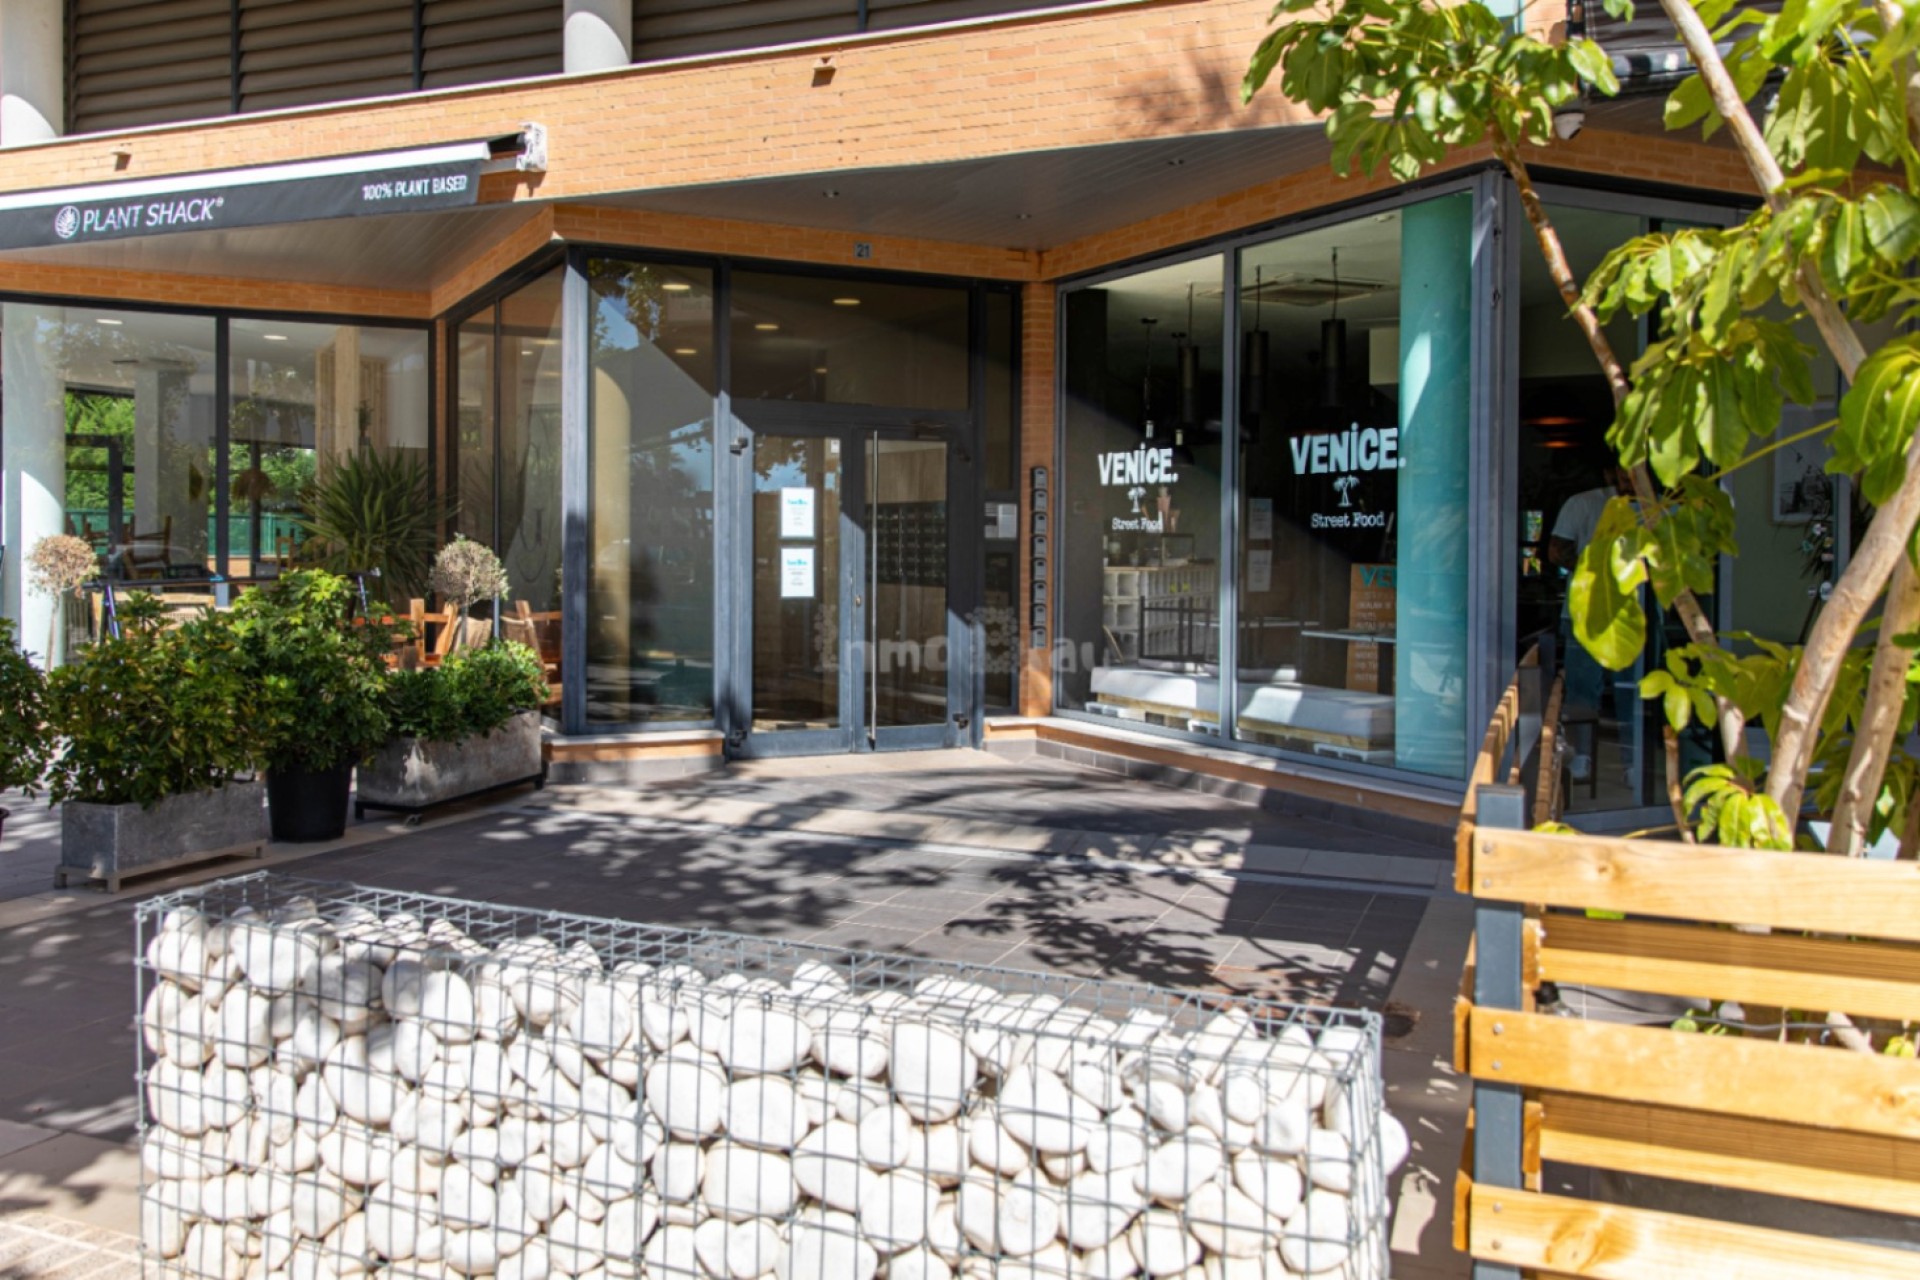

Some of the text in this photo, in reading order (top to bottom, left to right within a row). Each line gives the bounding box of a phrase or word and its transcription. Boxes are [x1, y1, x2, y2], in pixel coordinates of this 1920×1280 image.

[362, 175, 467, 200] 100% PLANT BASED
[83, 204, 144, 232] PLANT
[856, 243, 870, 258] 21
[1112, 516, 1139, 530] Street
[1311, 511, 1386, 529] Street Food
[1359, 565, 1397, 588] VE
